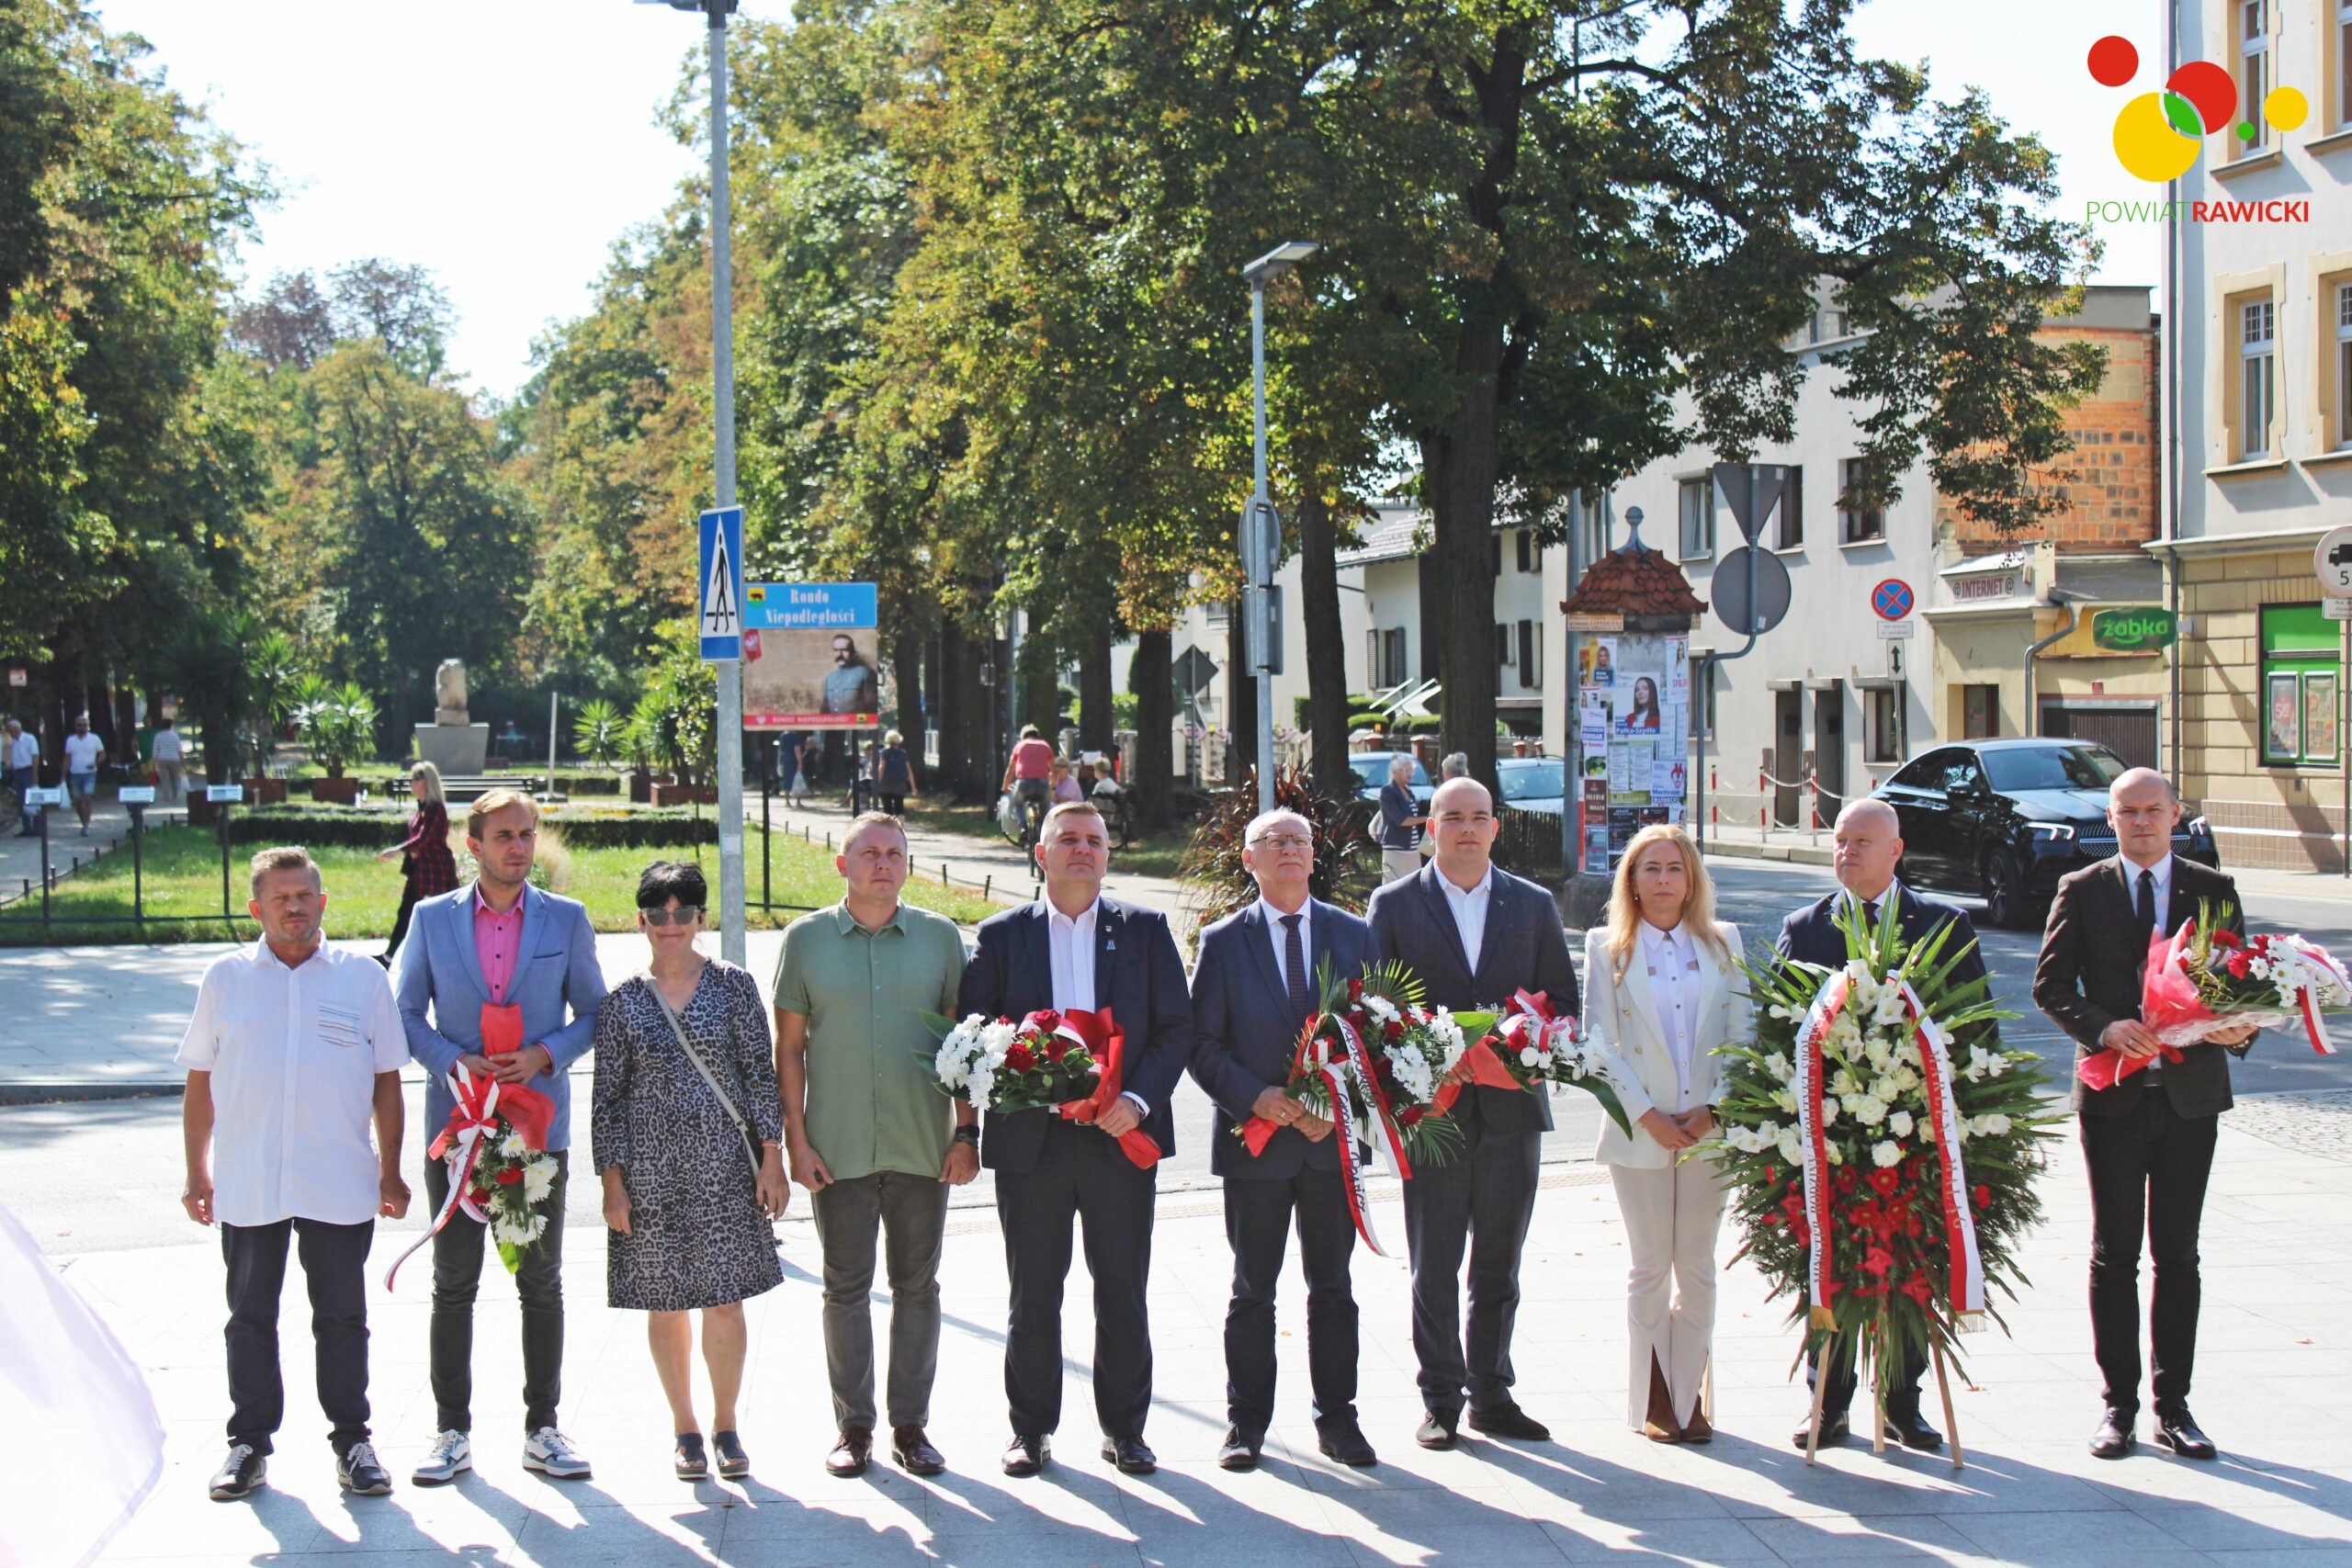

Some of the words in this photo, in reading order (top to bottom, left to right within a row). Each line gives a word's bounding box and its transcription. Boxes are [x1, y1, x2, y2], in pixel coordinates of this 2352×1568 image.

[790, 589, 830, 604] Rondo
[1962, 577, 2004, 599] INTERNET
[765, 608, 855, 626] Niepodległości
[2103, 617, 2169, 637] żabka
[1801, 1075, 1818, 1139] POLITYKI
[1927, 1050, 1952, 1147] MARLENA
[1807, 1155, 1824, 1213] RODZINY
[1812, 1221, 1826, 1284] MINISTER
